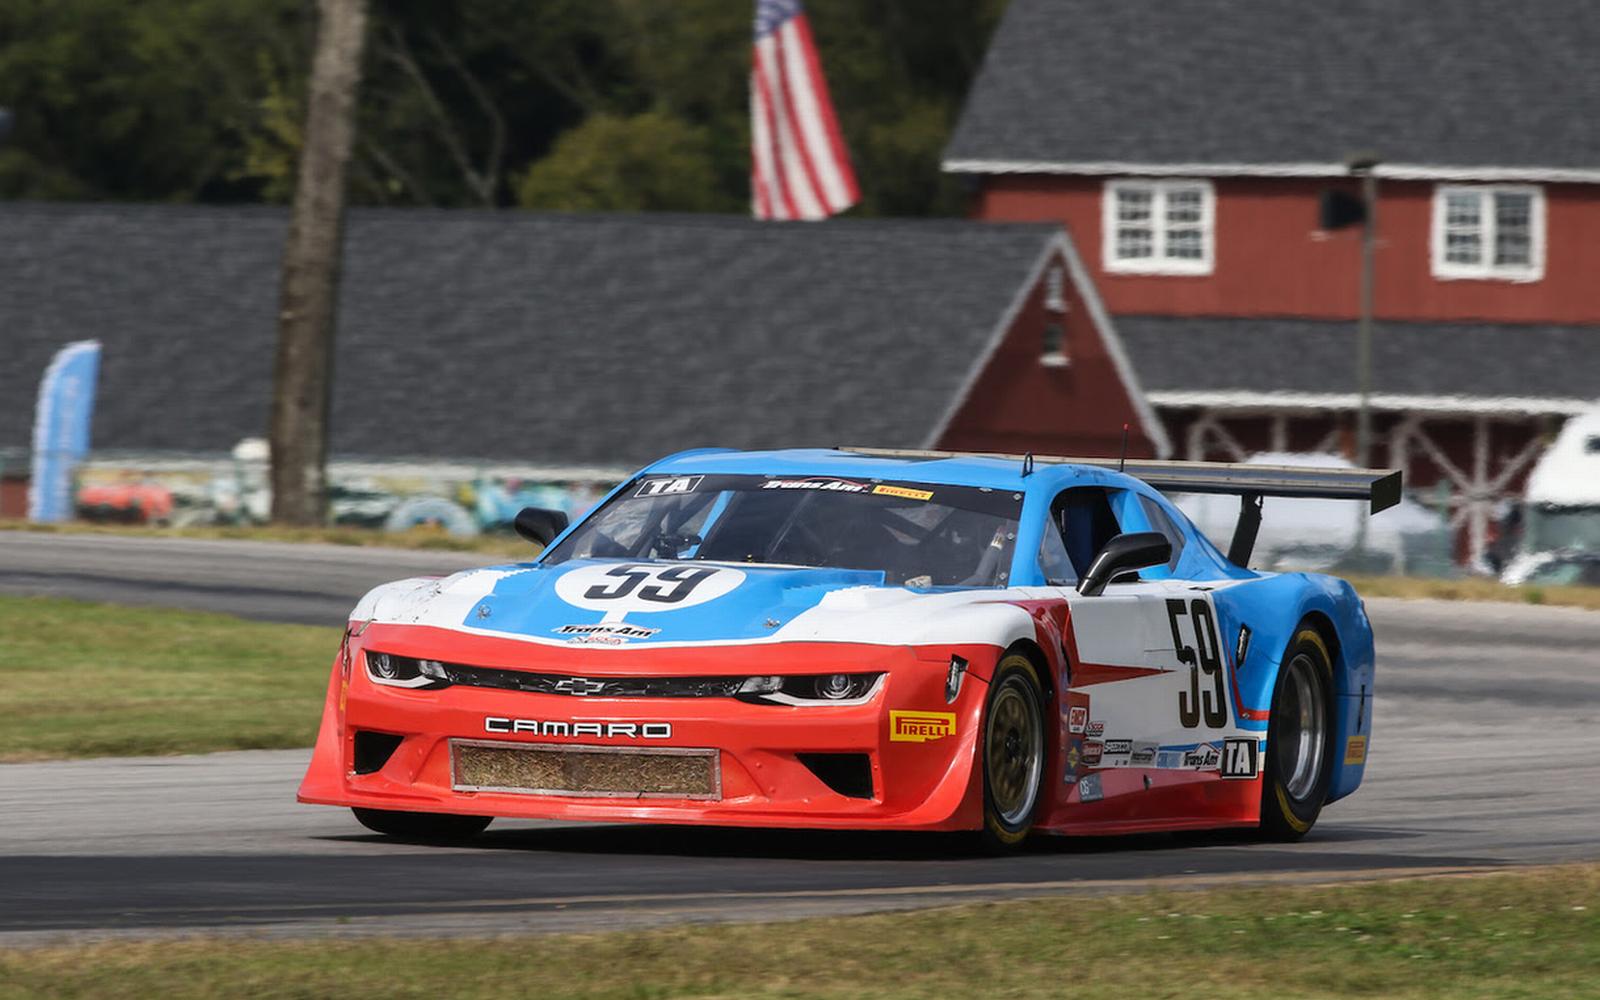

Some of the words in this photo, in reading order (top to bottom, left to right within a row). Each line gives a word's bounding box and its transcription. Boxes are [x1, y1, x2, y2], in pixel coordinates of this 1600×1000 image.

[648, 478, 690, 495] TA
[763, 480, 820, 490] Trans
[820, 481, 864, 492] Am
[583, 564, 722, 604] 59
[561, 625, 614, 634] Trans
[615, 626, 654, 638] Am
[1165, 598, 1228, 729] 59
[484, 716, 673, 740] CAMARO
[895, 715, 951, 737] PIRELLI
[1184, 752, 1203, 767] Trans
[1225, 741, 1251, 774] TA
